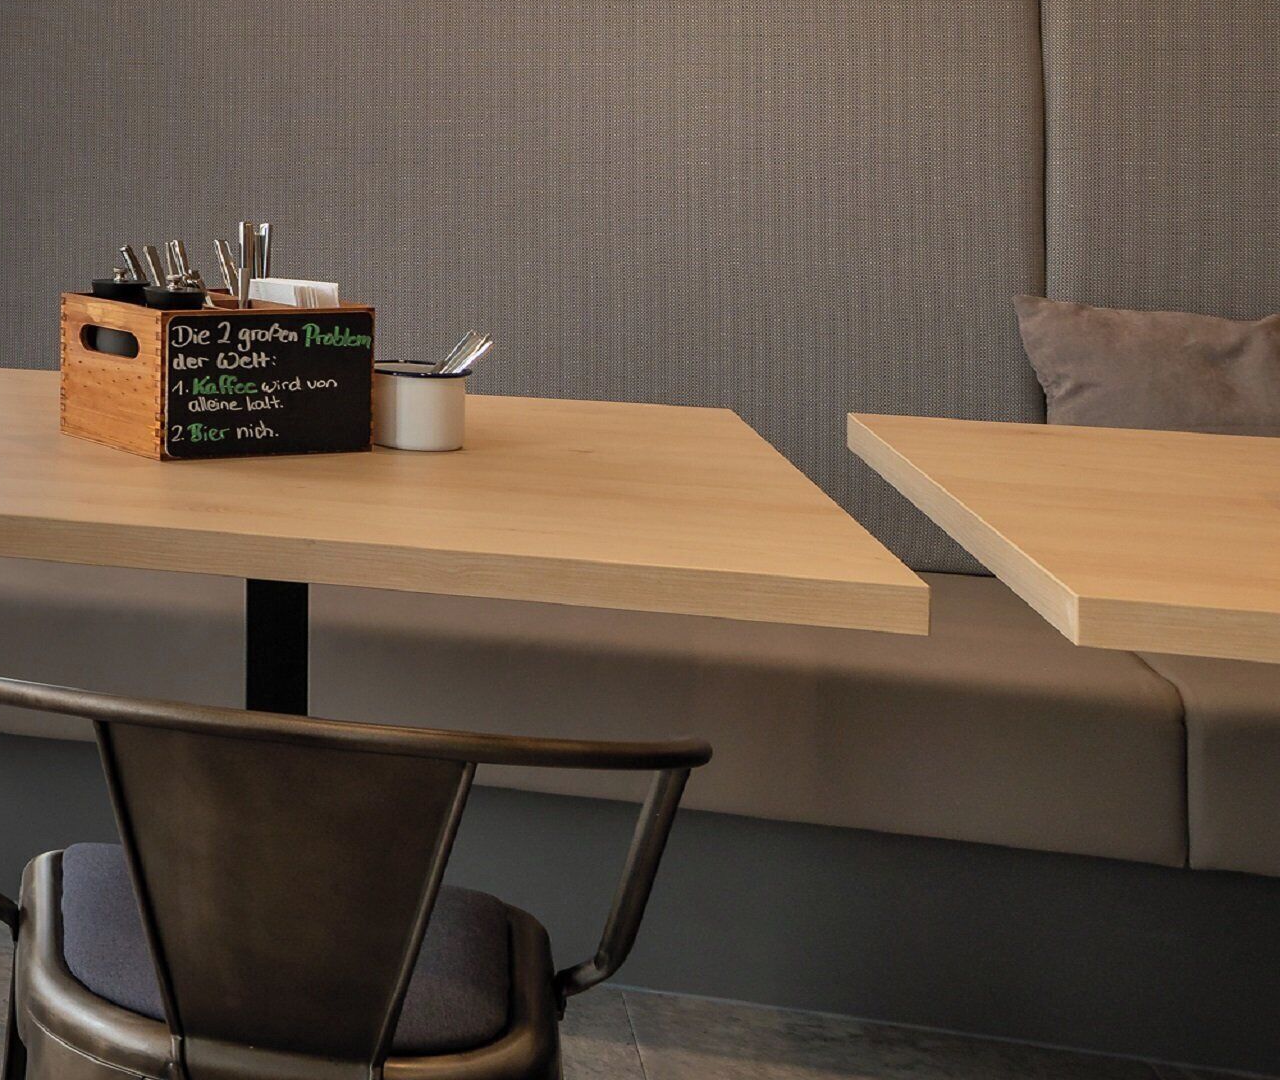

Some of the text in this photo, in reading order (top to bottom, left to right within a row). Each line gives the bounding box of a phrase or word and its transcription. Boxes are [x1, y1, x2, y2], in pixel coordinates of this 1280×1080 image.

[171, 324, 211, 348] Die
[217, 321, 231, 344] 2
[237, 323, 298, 352] großen
[173, 351, 278, 371] der Welt:
[172, 375, 338, 396] 1. Kaffee wird von
[188, 396, 284, 412] alleine kalt.
[171, 425, 185, 442] 2.
[187, 422, 230, 442] Bier
